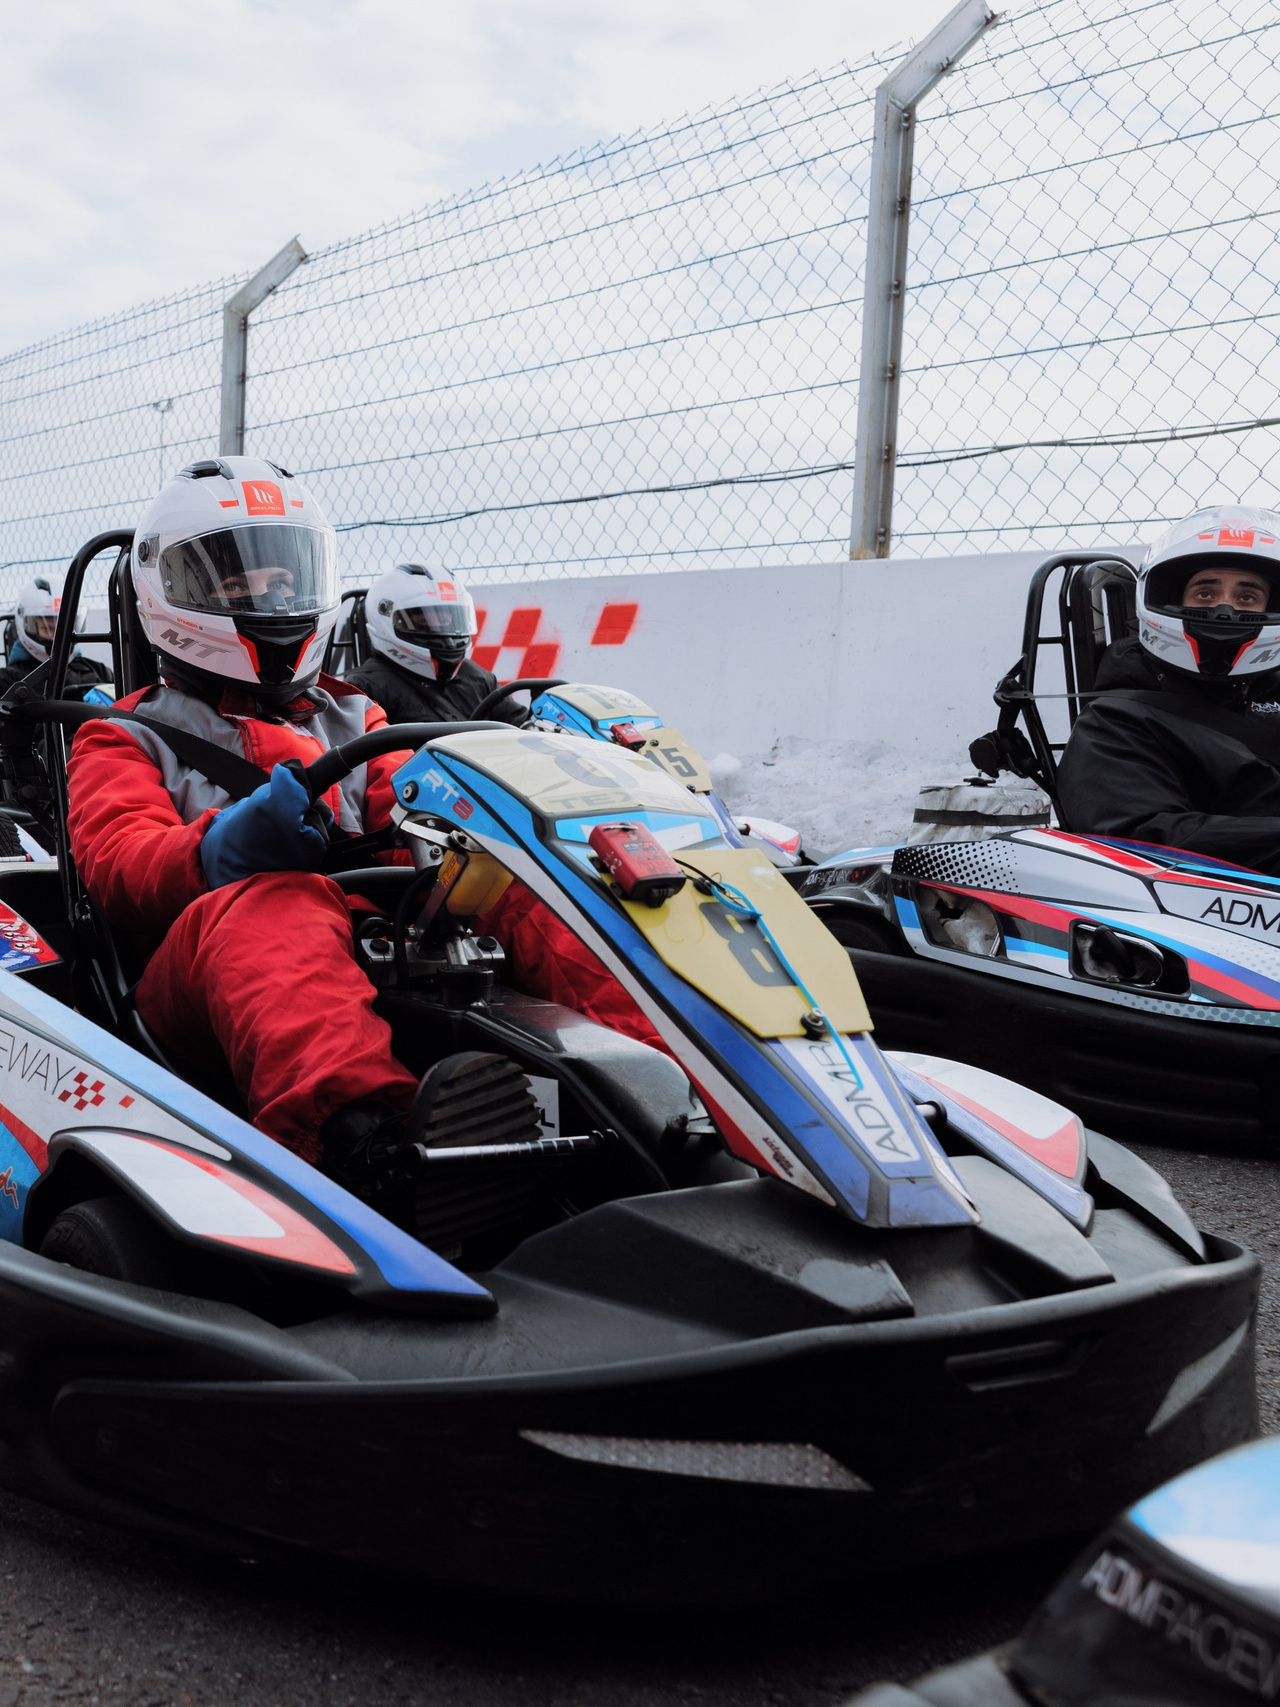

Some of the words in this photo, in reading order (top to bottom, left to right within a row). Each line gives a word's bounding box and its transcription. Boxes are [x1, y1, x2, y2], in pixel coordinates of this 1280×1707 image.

[160, 628, 237, 659] MT
[517, 735, 640, 789] 8
[642, 747, 698, 777] 15
[421, 768, 474, 820] RT8
[698, 902, 801, 987] 8
